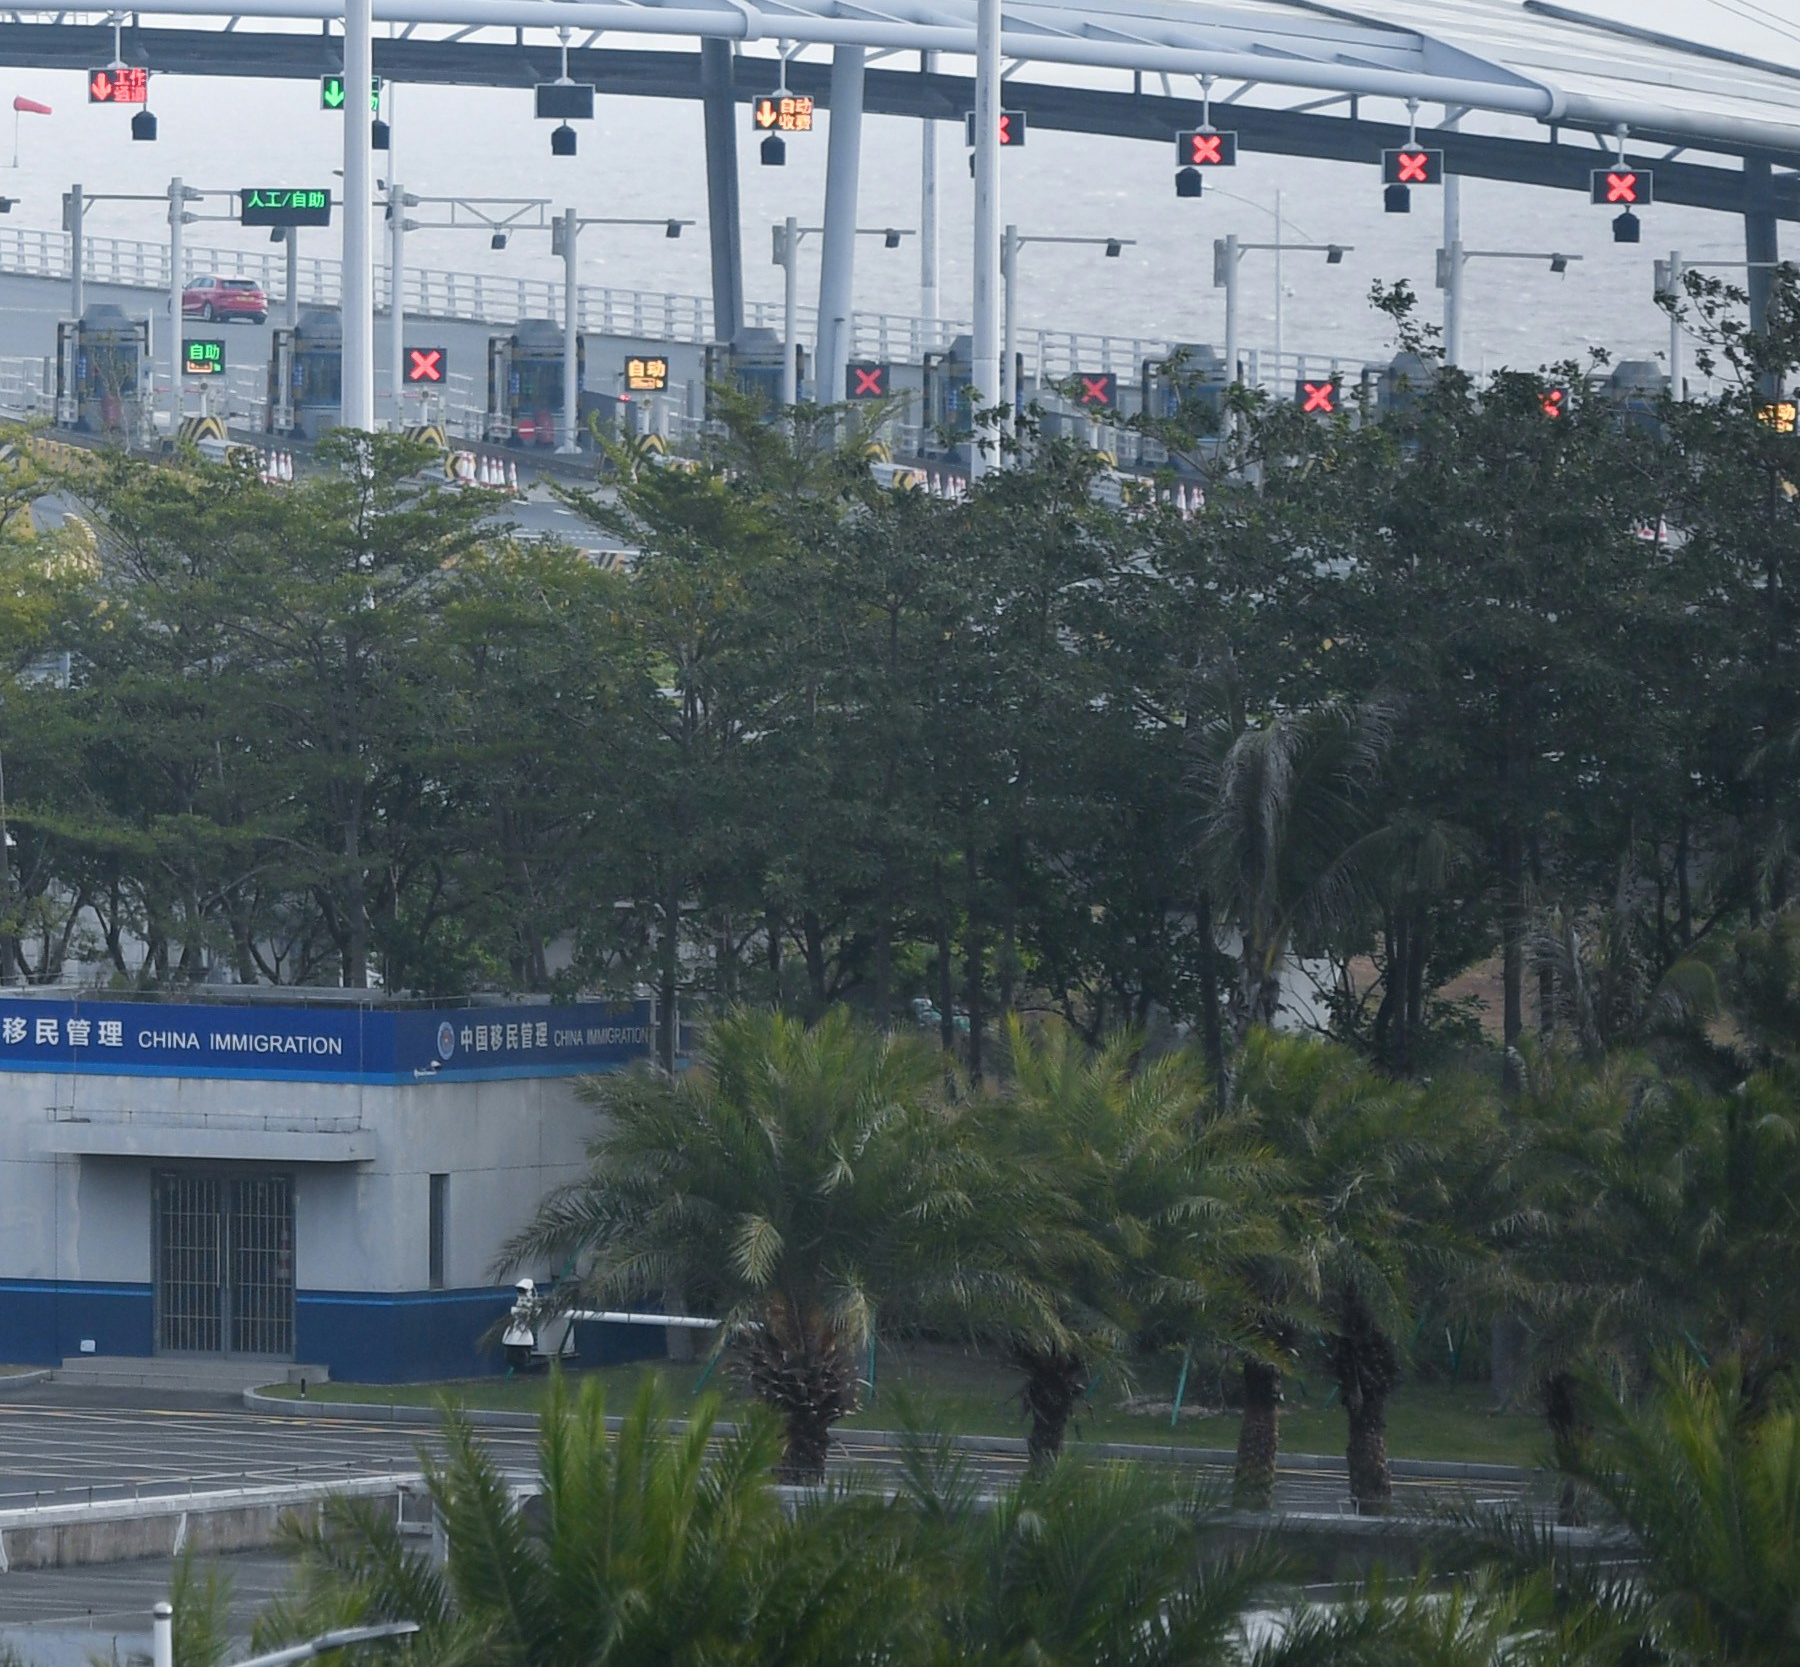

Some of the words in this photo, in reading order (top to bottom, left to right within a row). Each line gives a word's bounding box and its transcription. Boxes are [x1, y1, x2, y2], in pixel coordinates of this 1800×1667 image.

[114, 68, 146, 86] 工作
[780, 98, 813, 114] 自动
[779, 114, 813, 131] 收费
[246, 191, 325, 209] 人工/自助
[190, 344, 220, 361] 自助
[628, 359, 666, 377] 自动
[138, 1031, 200, 1050] CHINA
[209, 1033, 343, 1056] IMMIGRATION
[460, 1021, 548, 1053] 中国移民管理
[553, 1029, 583, 1048] CHINA
[587, 1026, 649, 1046] IMMIGRATION
